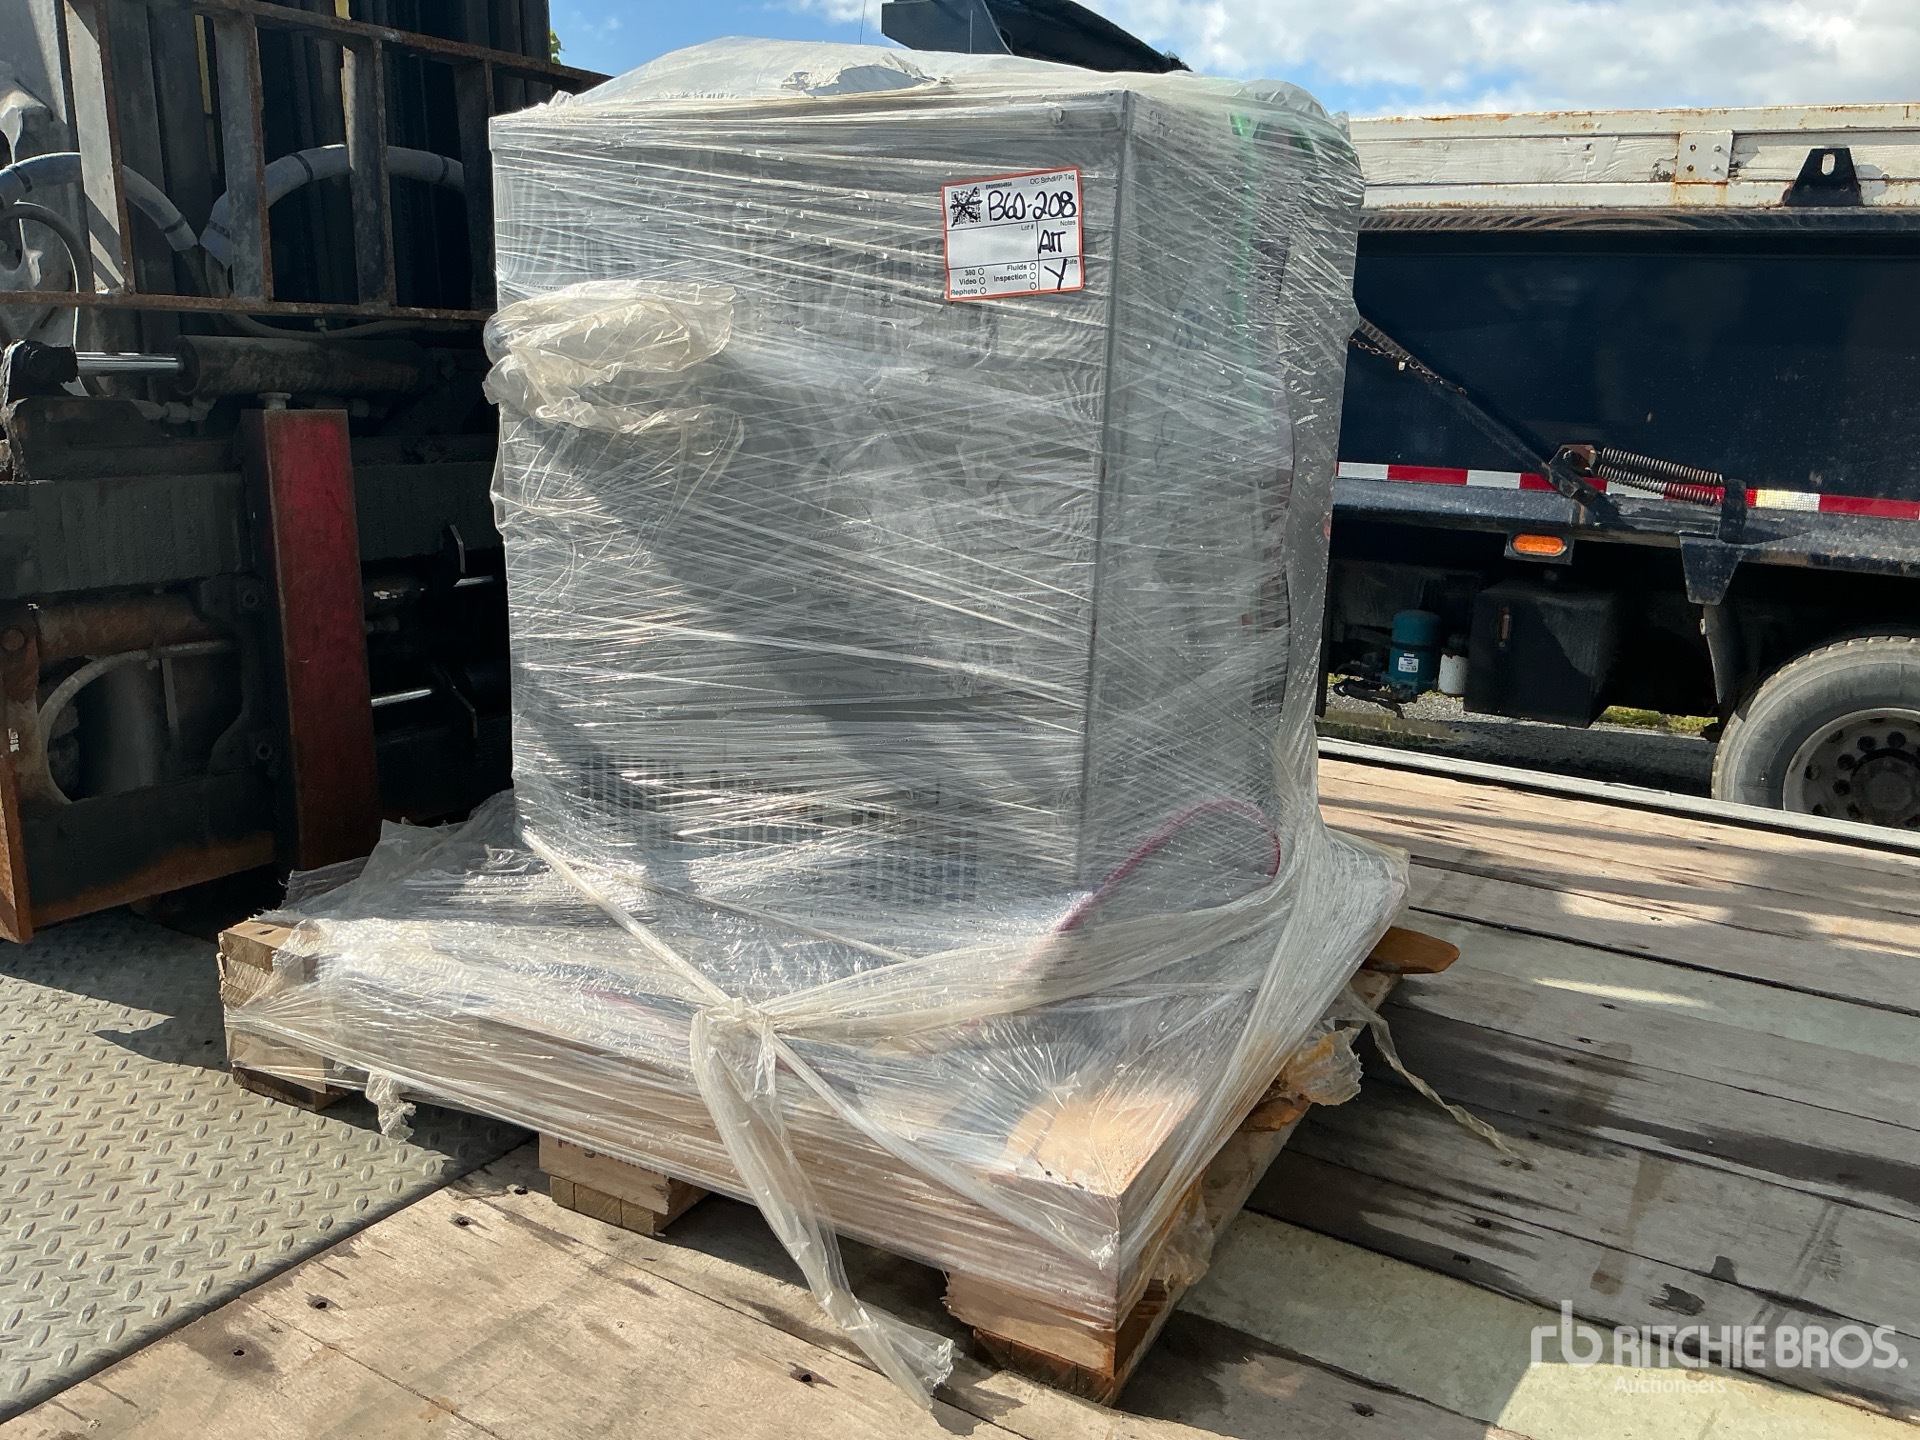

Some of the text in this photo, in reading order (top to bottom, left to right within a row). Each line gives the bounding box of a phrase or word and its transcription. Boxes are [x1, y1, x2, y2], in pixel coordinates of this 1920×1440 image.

[1064, 173, 1075, 181] Tag
[993, 273, 1028, 282] Inspection
[1044, 258, 1067, 290] Y
[950, 288, 978, 296] Rephoto
